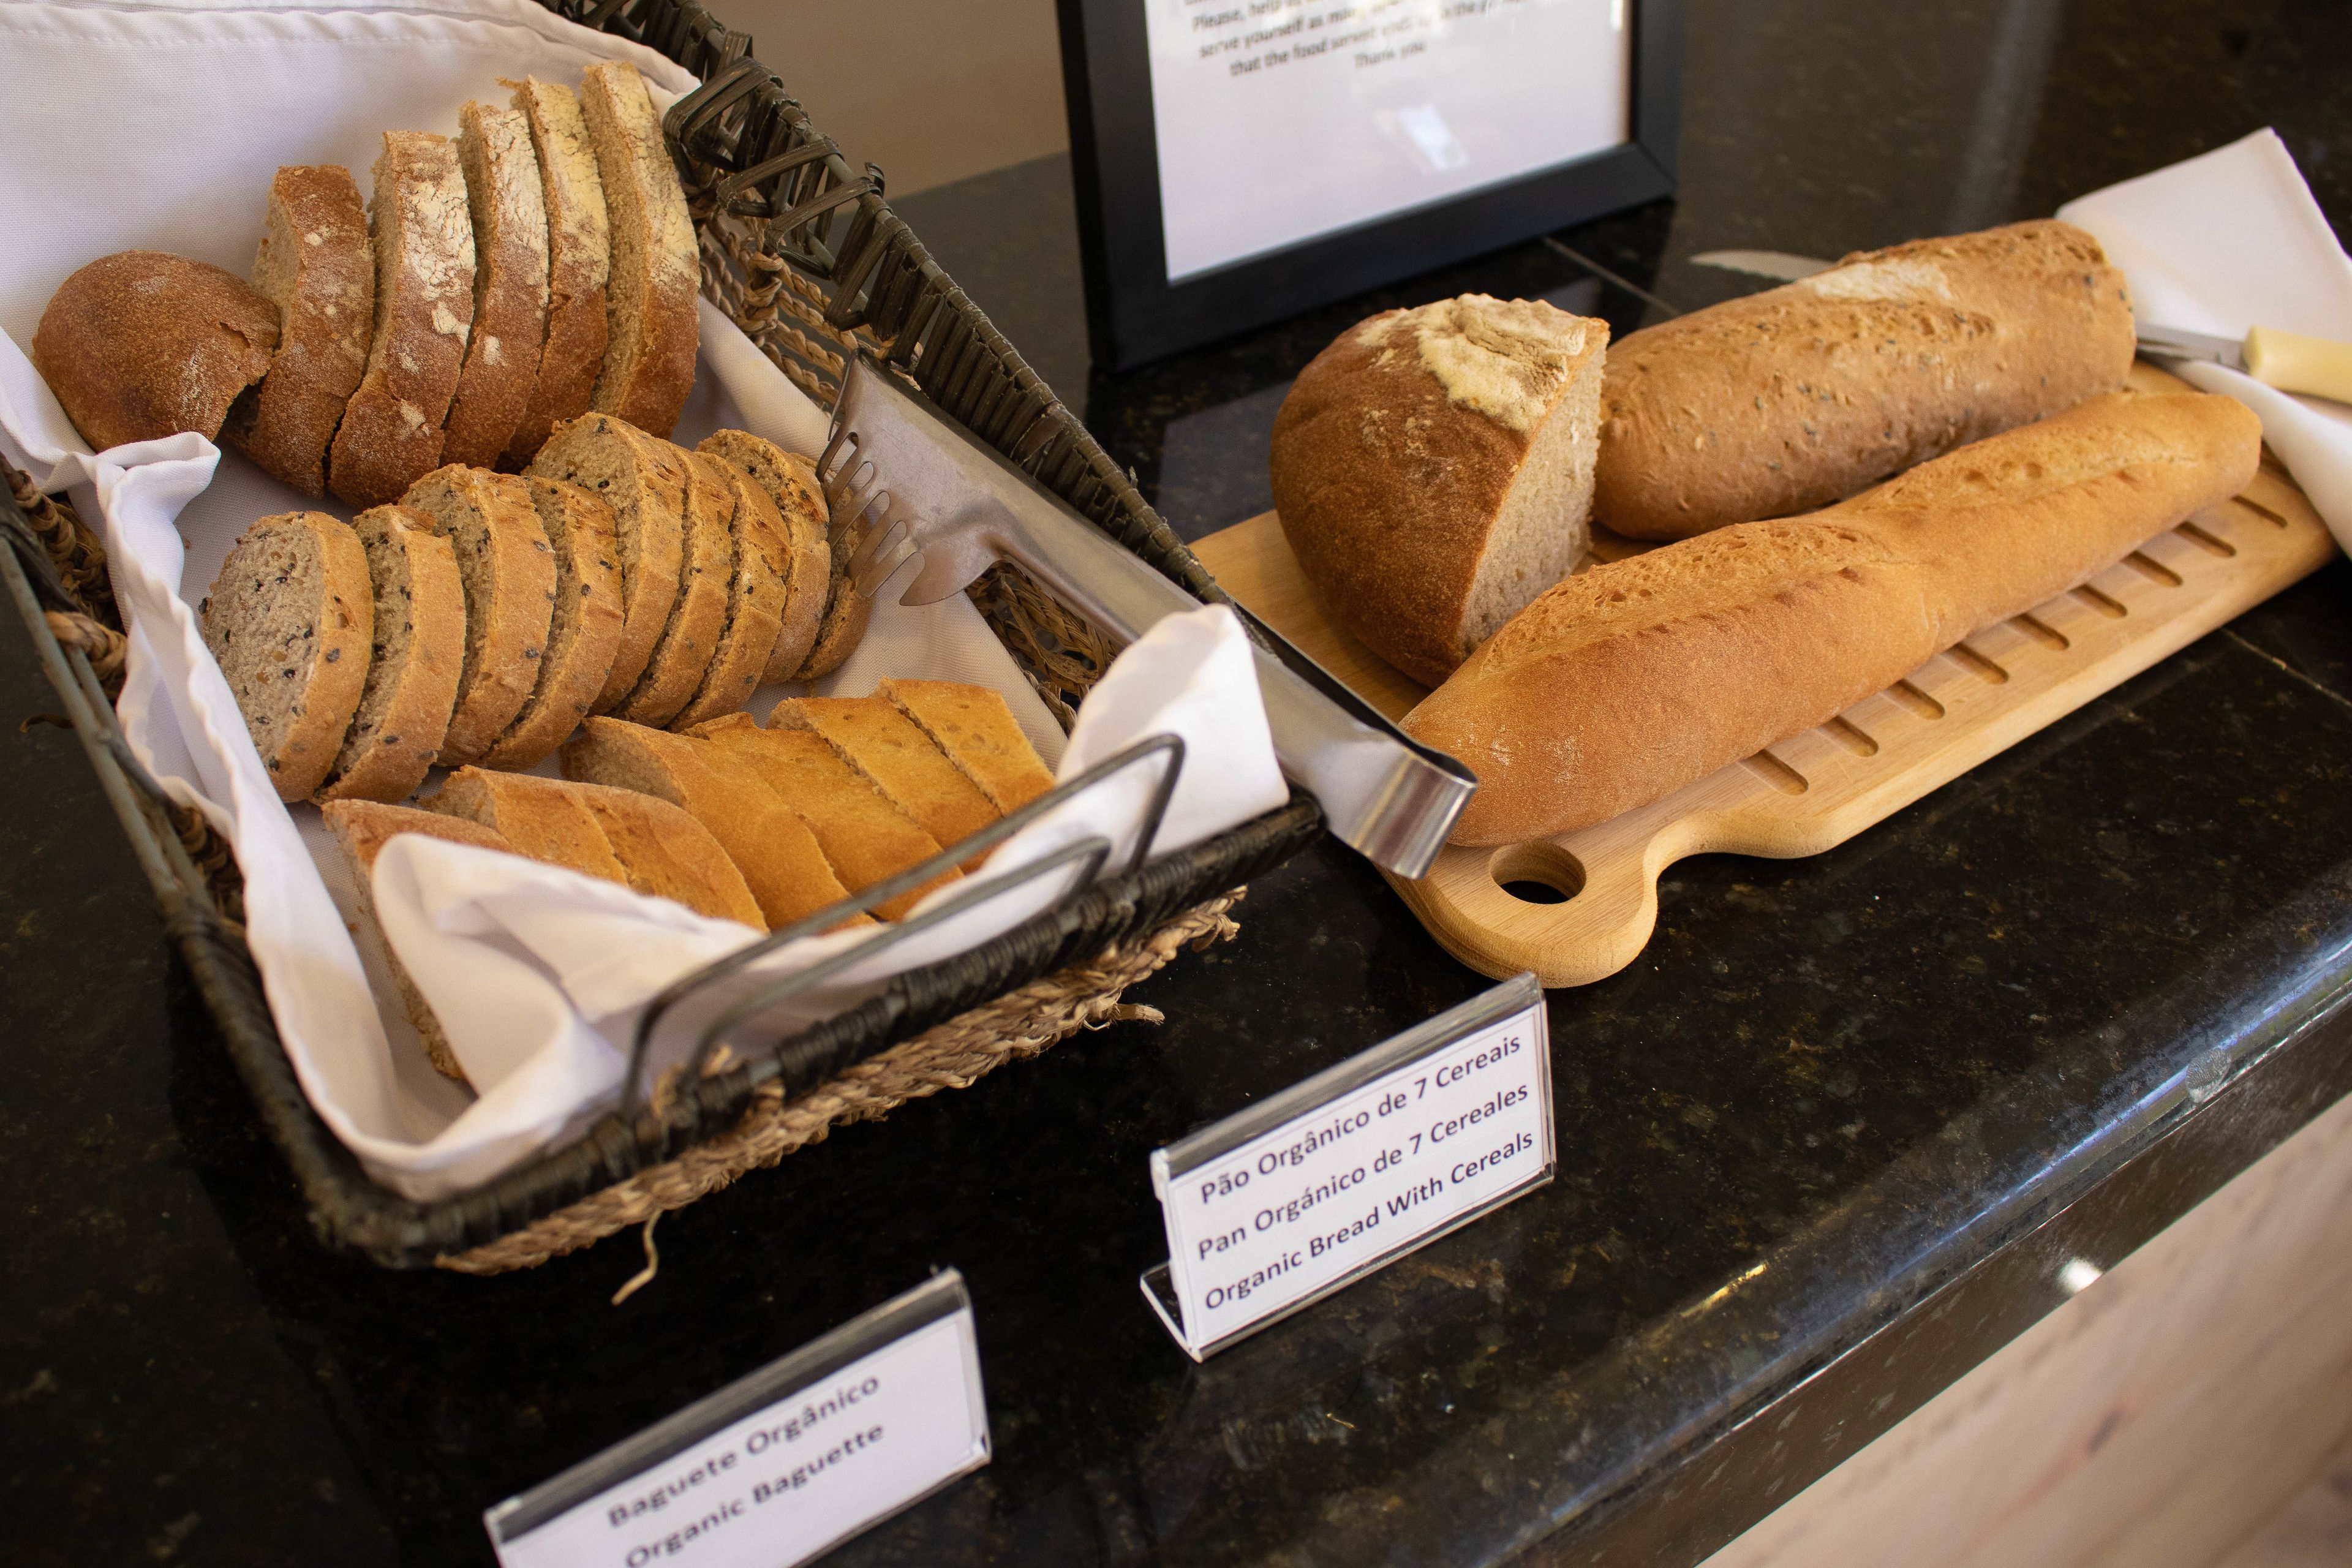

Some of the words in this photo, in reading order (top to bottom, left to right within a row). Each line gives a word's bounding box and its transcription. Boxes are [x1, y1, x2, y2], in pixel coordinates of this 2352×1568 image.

[1244, 14, 1304, 48] yourself
[1264, 50, 1289, 67] the
[1293, 37, 1328, 58] food
[1197, 1226, 1247, 1262] Pan
[1253, 1166, 1367, 1233] Orgánico
[1373, 1148, 1403, 1174] de
[1408, 1131, 1423, 1156] 7
[1429, 1084, 1529, 1144] Cereales
[1200, 1170, 1251, 1205] Pão
[1257, 1110, 1371, 1177] Orgânico
[1377, 1092, 1408, 1118] de
[1413, 1076, 1428, 1100] 7
[1434, 1036, 1521, 1089] Cereais
[1204, 1250, 1303, 1311] Organic
[1308, 1205, 1381, 1259] Bread
[1385, 1176, 1444, 1218] With
[1450, 1131, 1534, 1185] Cereals
[606, 1452, 737, 1528] Baguete
[745, 1376, 880, 1456] Orgânico
[624, 1499, 744, 1568] Organic
[751, 1425, 884, 1505] Baguette
